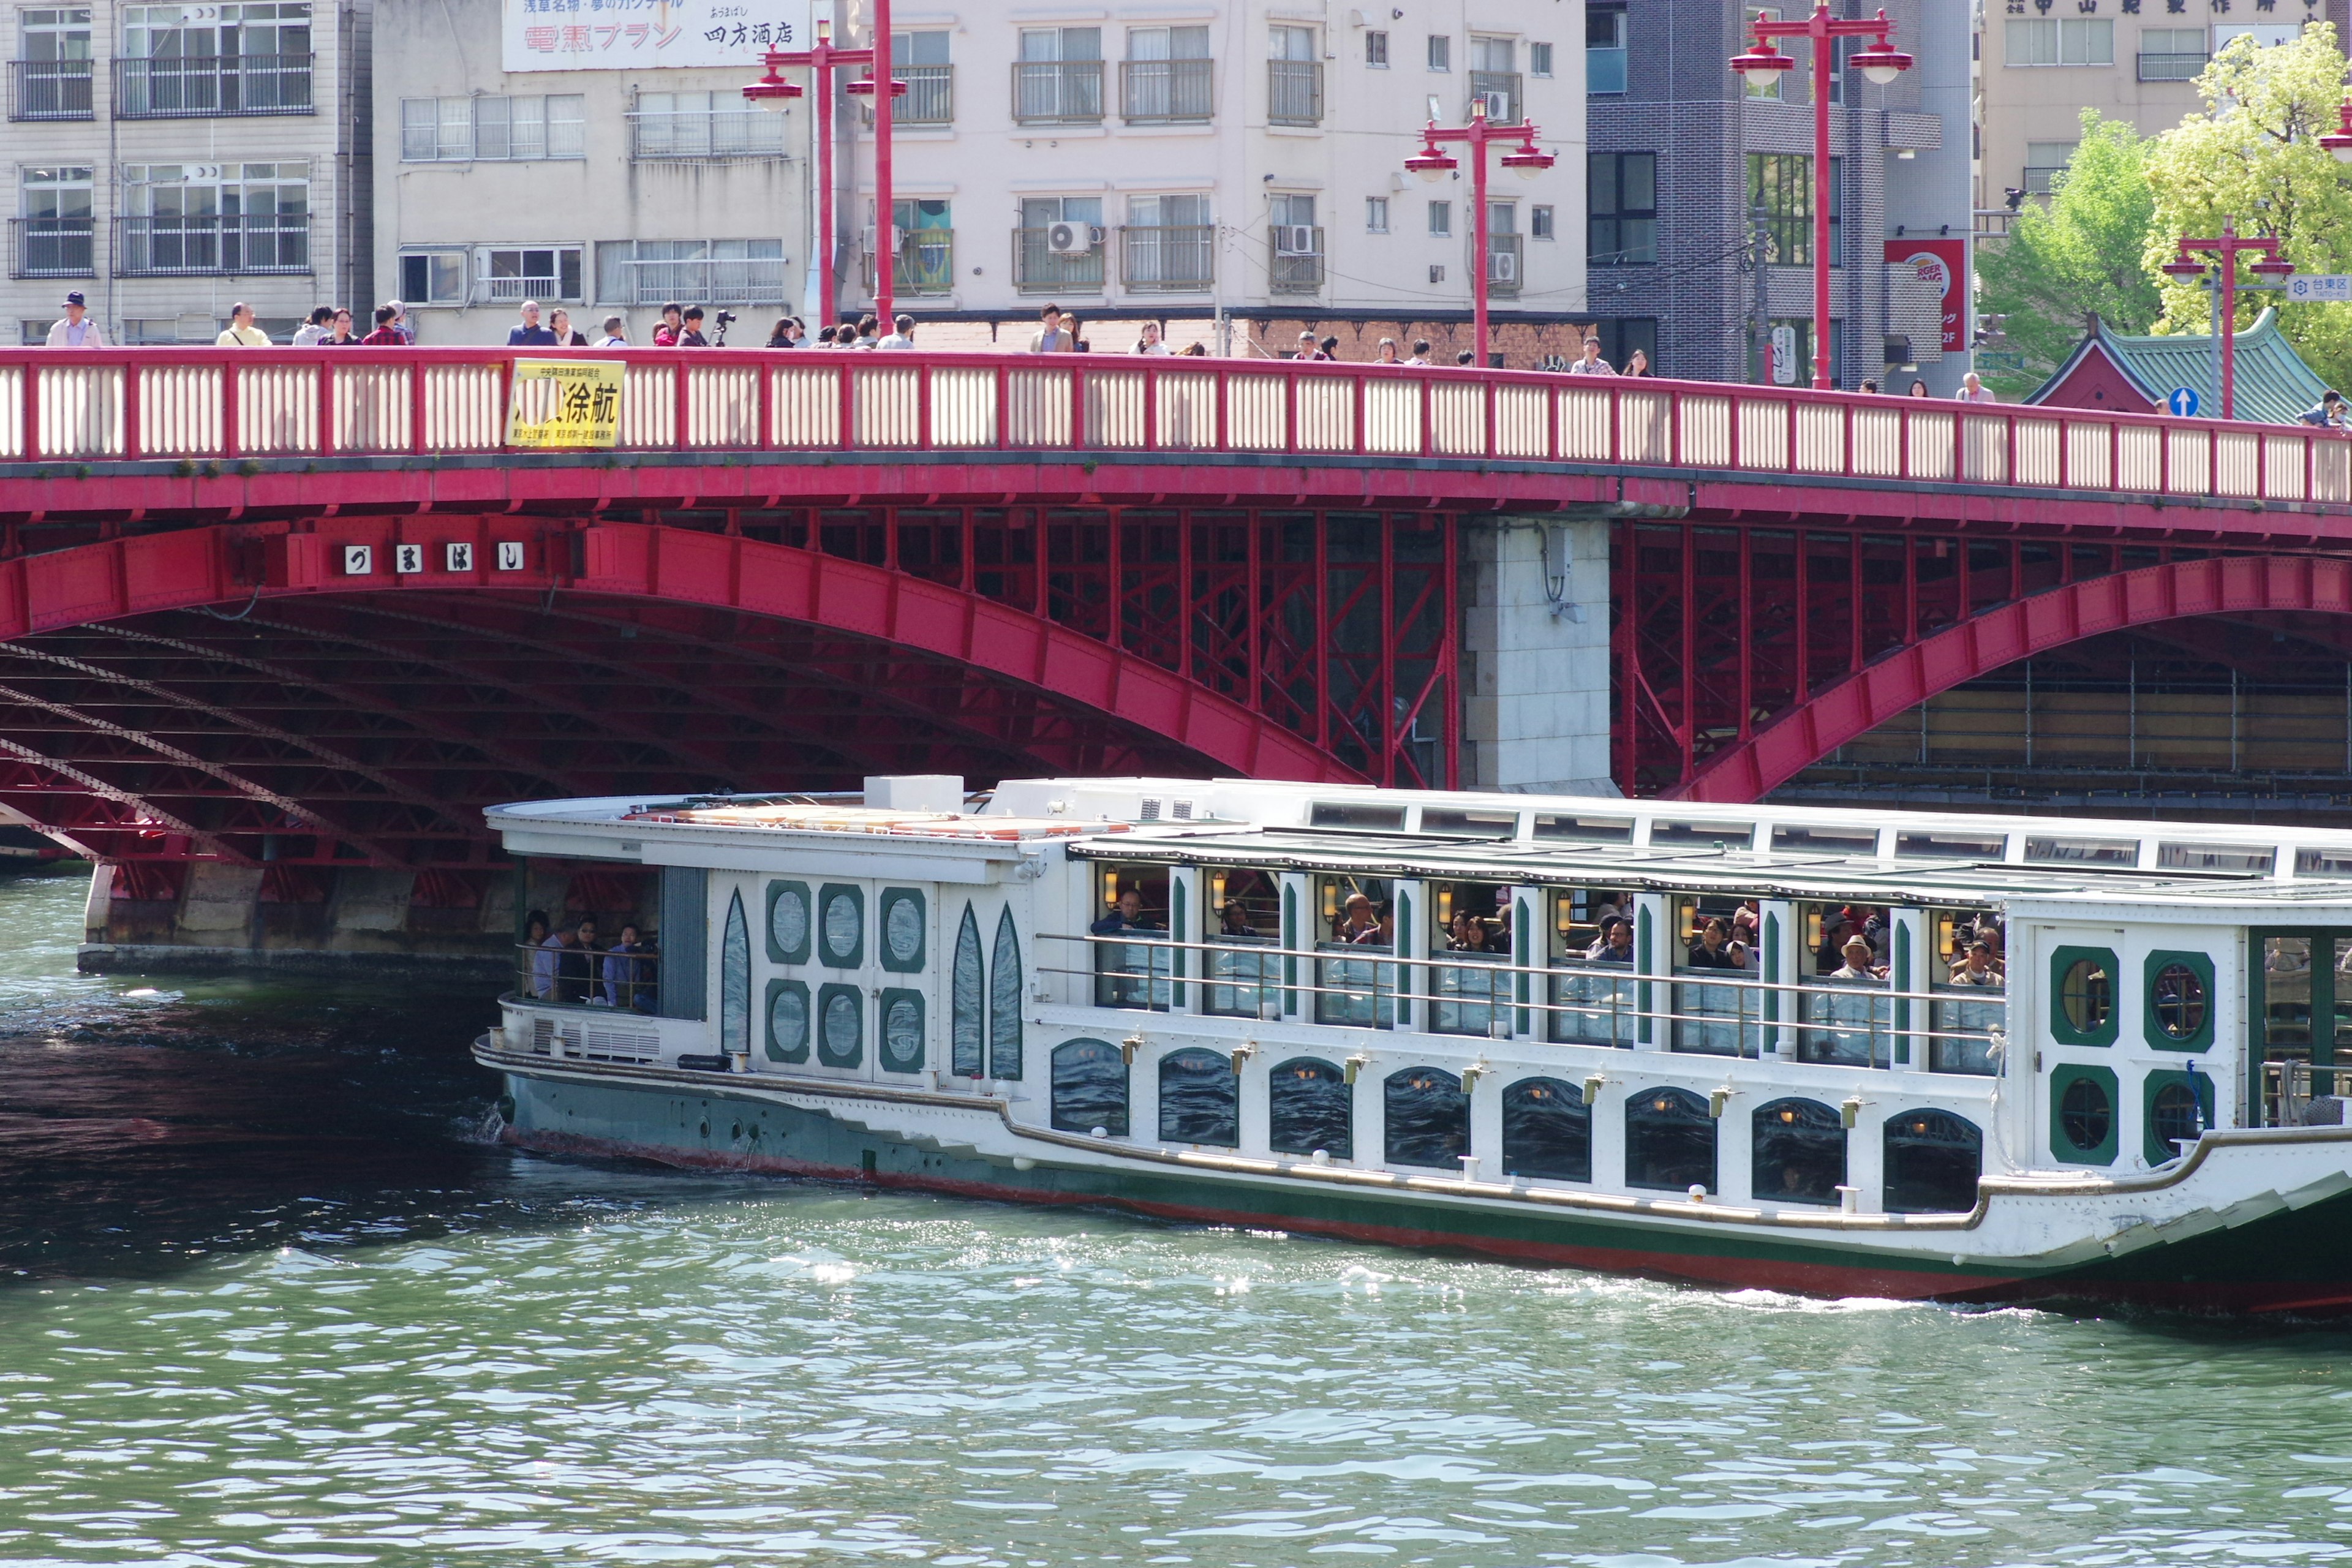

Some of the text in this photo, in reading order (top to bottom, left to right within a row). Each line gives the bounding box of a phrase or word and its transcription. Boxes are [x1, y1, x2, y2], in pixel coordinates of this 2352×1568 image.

[524, 21, 682, 53] 電氣ブラン
[704, 21, 793, 47] 四方酒店
[2313, 279, 2347, 290] 台東区
[1942, 332, 1955, 343] 2F
